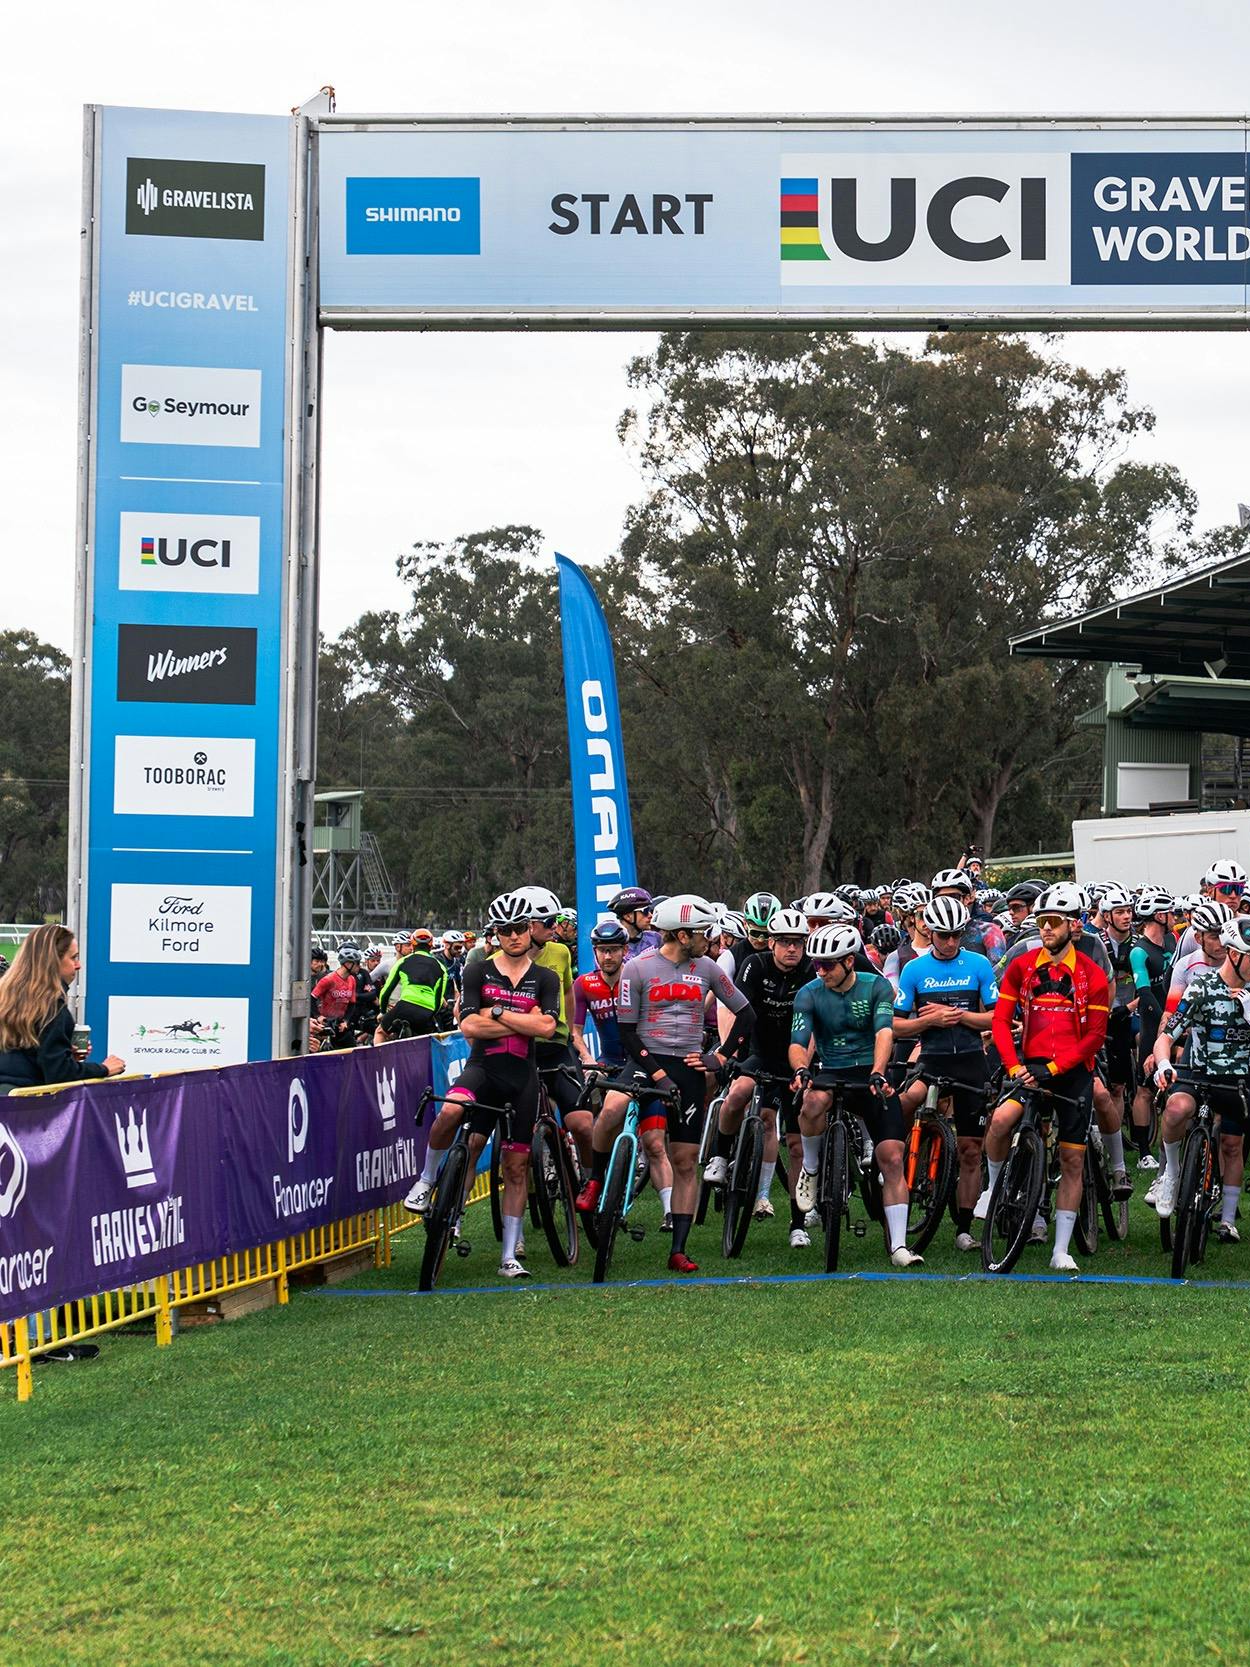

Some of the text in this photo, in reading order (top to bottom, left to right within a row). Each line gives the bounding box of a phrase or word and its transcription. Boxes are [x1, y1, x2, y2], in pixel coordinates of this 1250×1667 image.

[162, 189, 254, 211] GRAVELISTA
[365, 206, 461, 222] SHIMANO
[548, 193, 714, 236] START
[831, 176, 1047, 262] UCI
[127, 290, 259, 312] #UCIGRAVEL
[164, 398, 250, 417] Seymour
[157, 537, 231, 568] UCI
[147, 647, 228, 682] Winners
[143, 767, 226, 786] TOOBORAC
[158, 895, 204, 915] Ford
[149, 918, 214, 933] Kilmore
[162, 938, 200, 952] Ford
